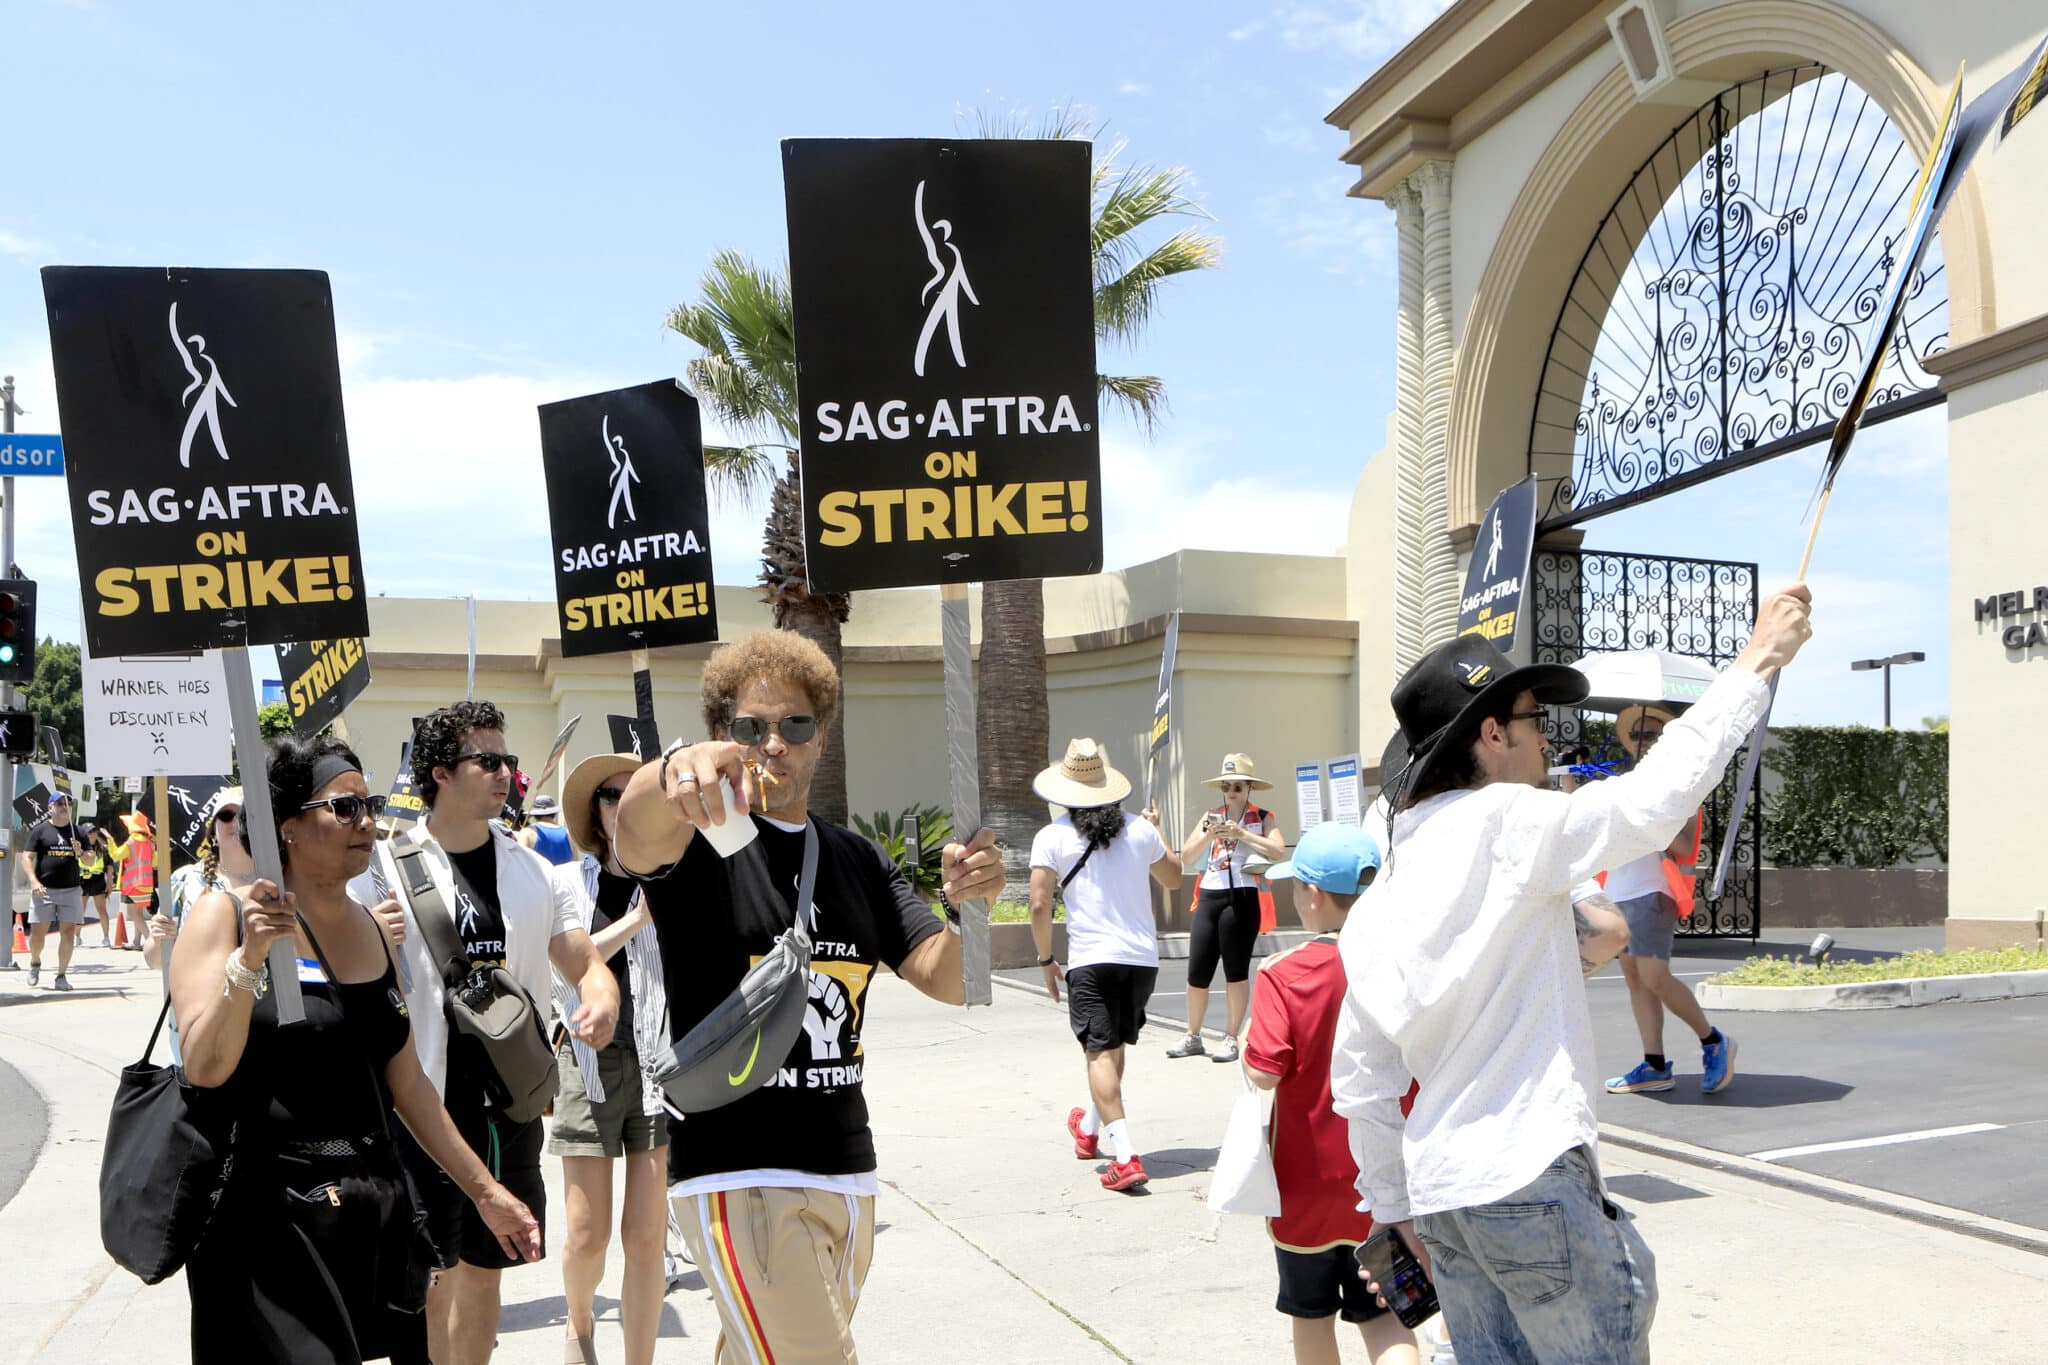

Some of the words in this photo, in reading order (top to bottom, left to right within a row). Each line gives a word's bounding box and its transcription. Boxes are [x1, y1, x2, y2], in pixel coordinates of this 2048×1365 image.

[0, 444, 56, 466] dsor
[924, 450, 977, 480] ON
[818, 480, 1089, 547] STRIKE!
[195, 530, 247, 557] ON
[94, 555, 354, 617] STRIKE!
[616, 569, 645, 589] ON
[565, 581, 709, 631] STRIKE!
[1458, 611, 1516, 641] IKE!
[2001, 620, 2048, 649] GA
[101, 678, 168, 696] WARNER
[178, 679, 210, 694] HOES
[289, 637, 363, 717] STRIKE!
[109, 709, 208, 727] DISCUNTERY
